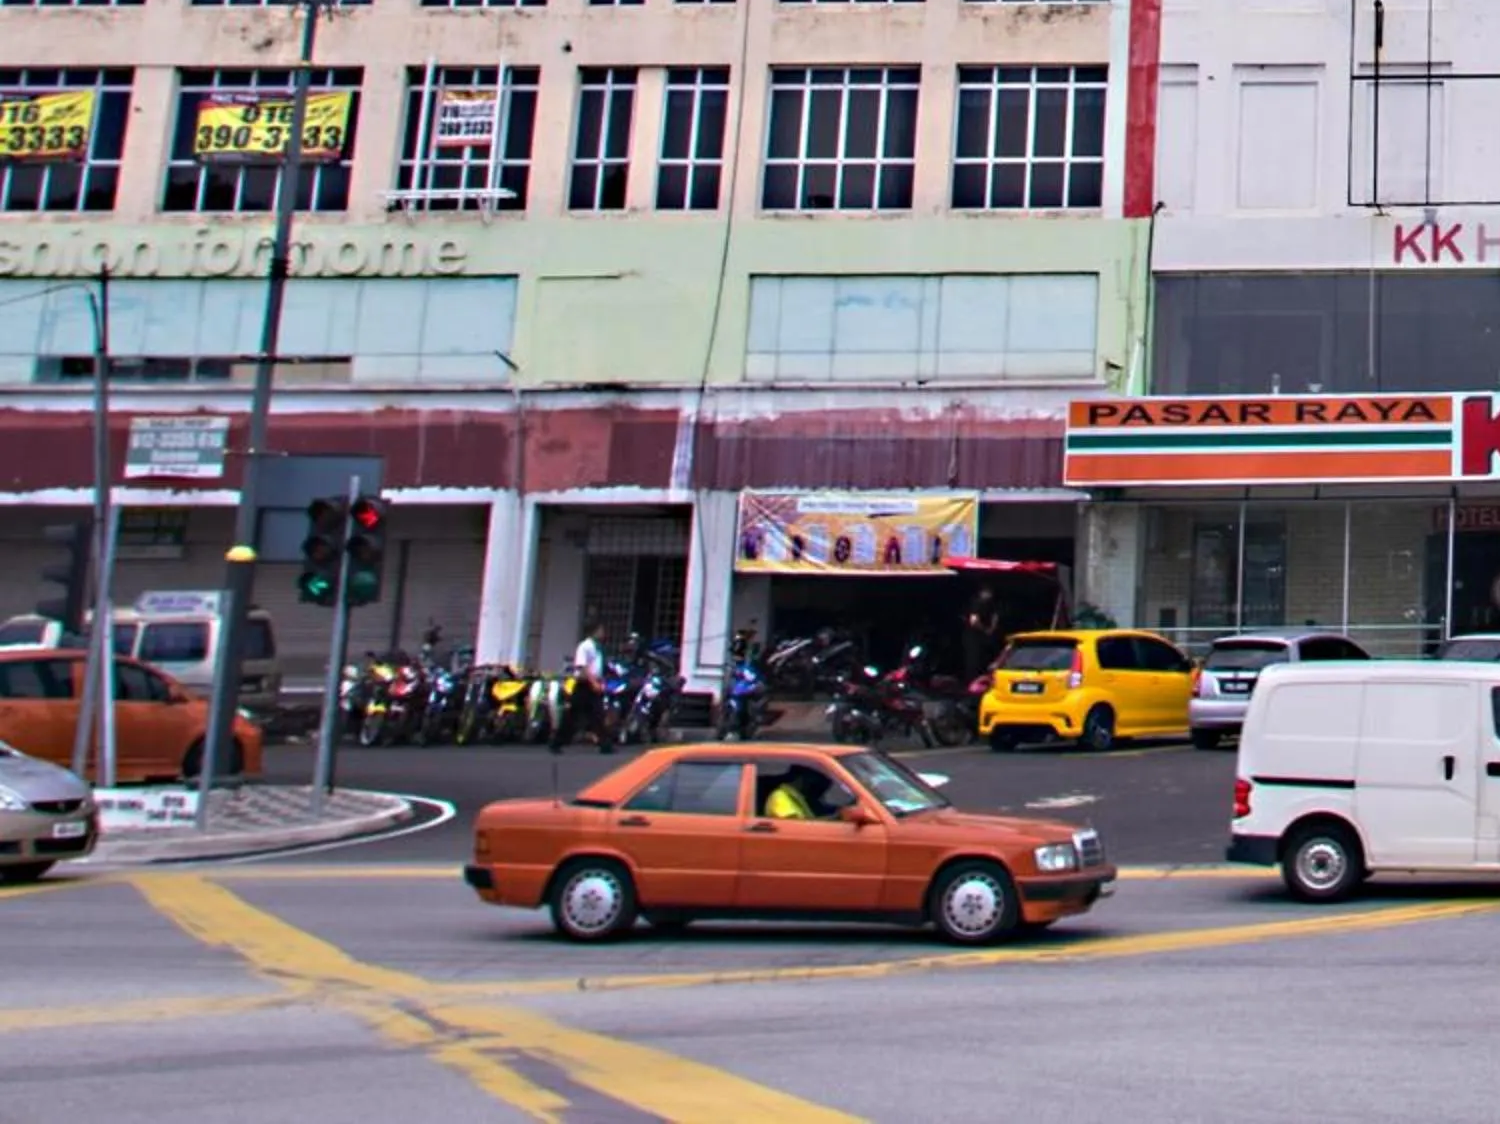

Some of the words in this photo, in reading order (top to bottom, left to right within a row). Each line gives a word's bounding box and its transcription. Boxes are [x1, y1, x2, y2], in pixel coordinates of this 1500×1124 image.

[198, 125, 342, 150] 390-333
[1393, 222, 1464, 264] KK
[1088, 401, 1271, 425] PASAR
[1295, 398, 1437, 424] RAYA
